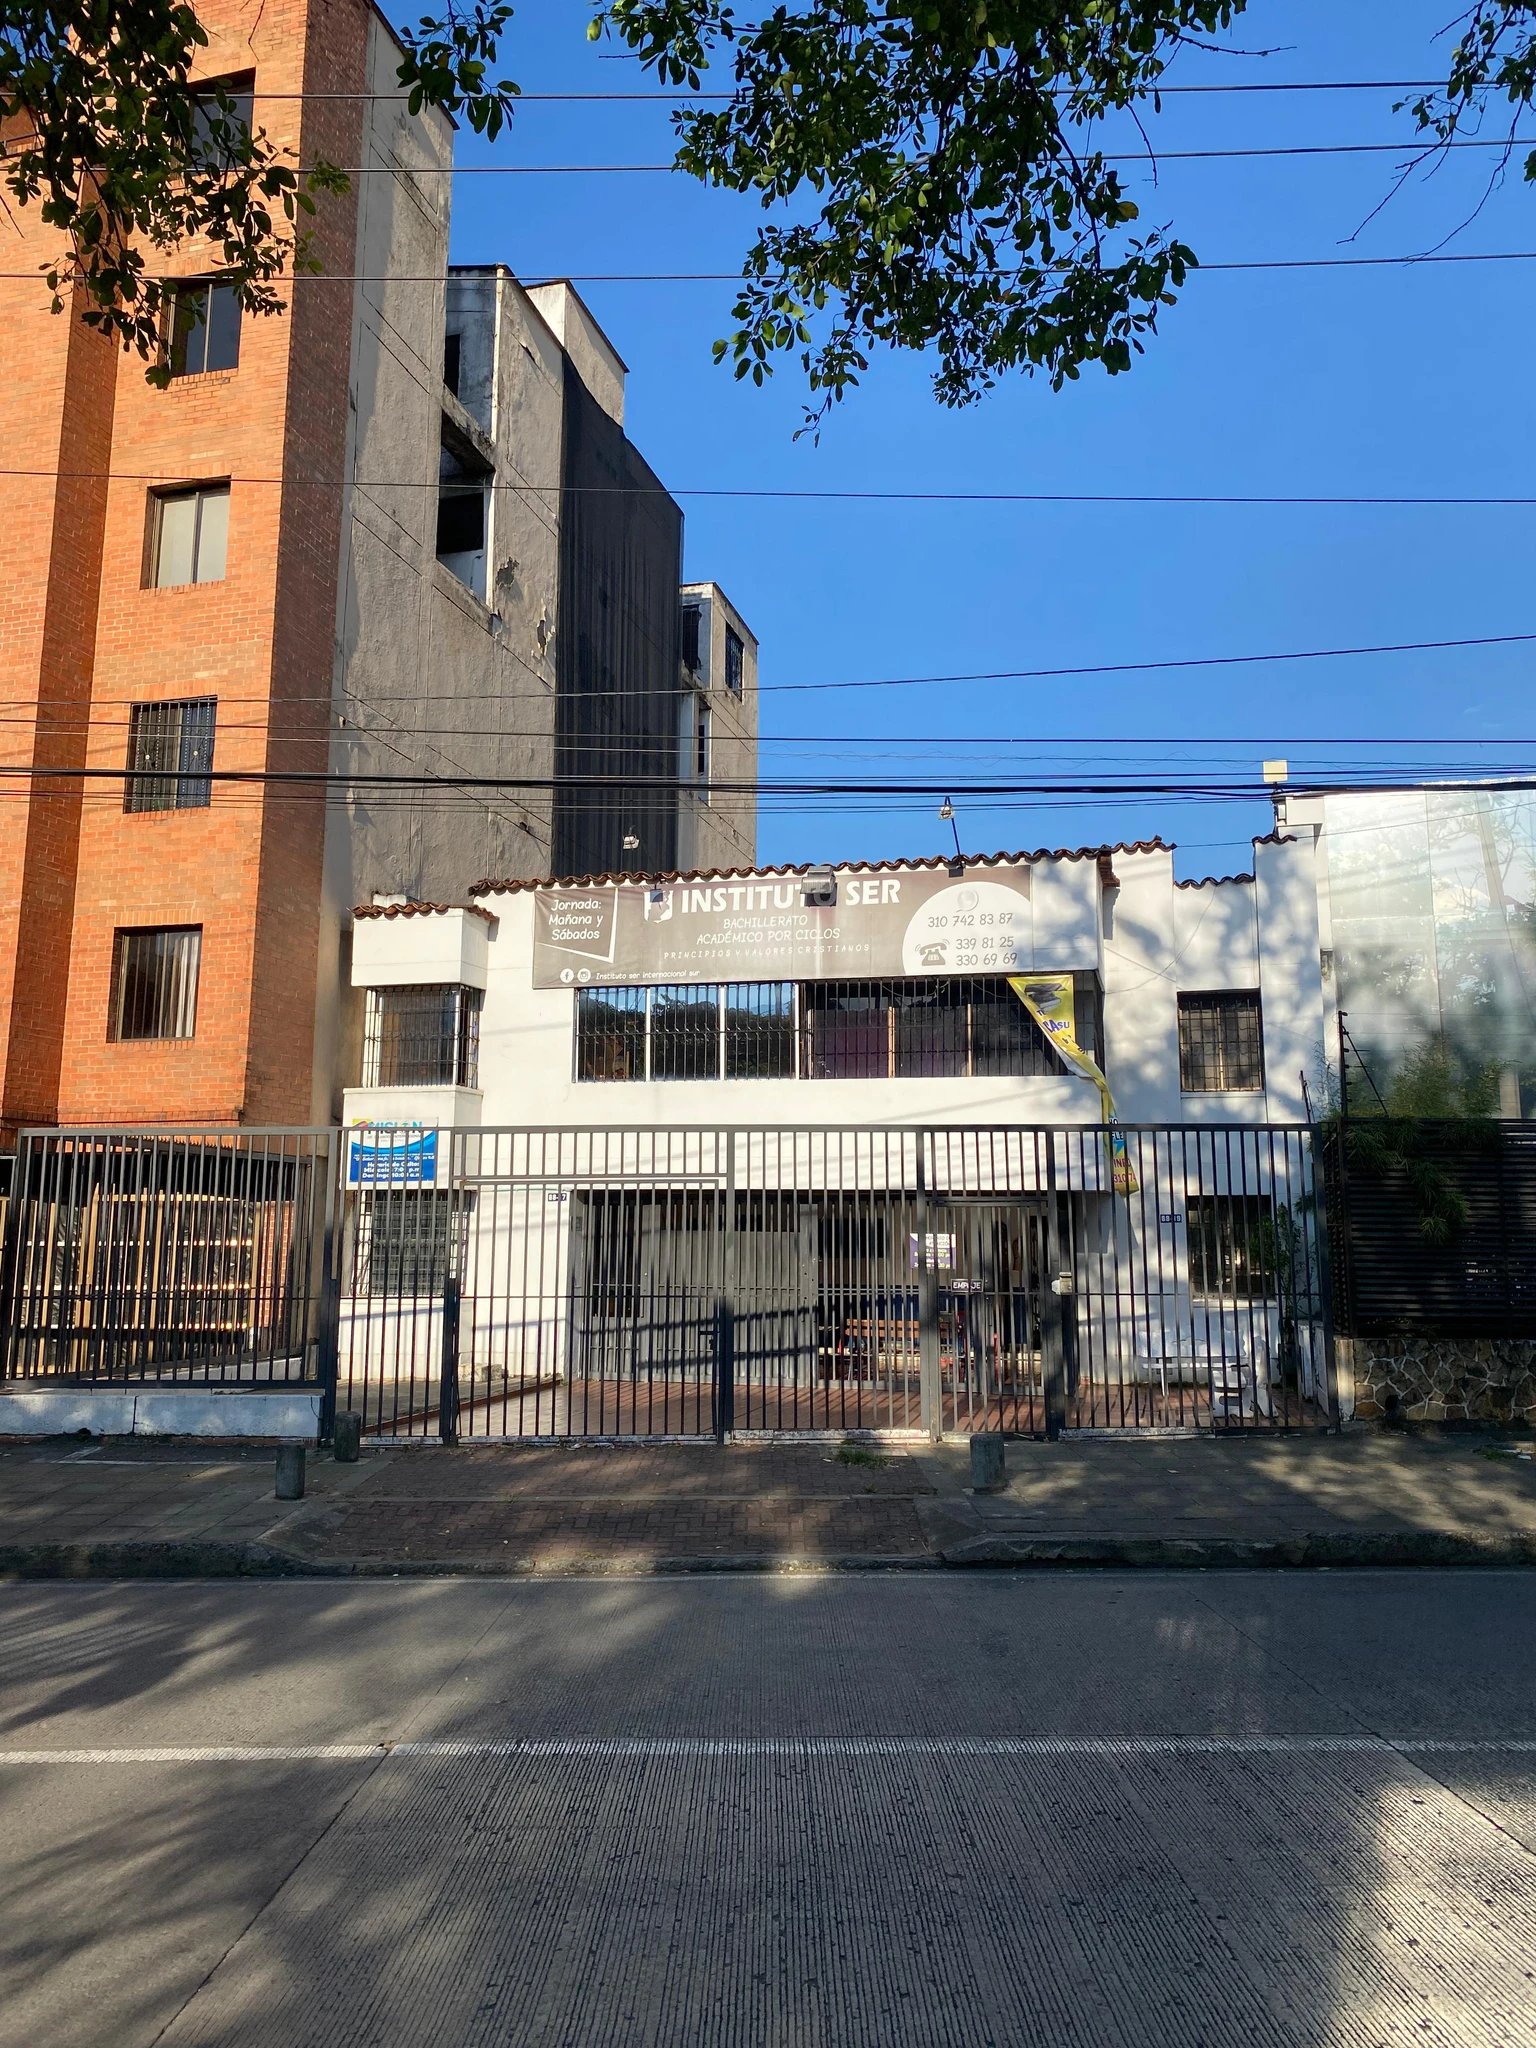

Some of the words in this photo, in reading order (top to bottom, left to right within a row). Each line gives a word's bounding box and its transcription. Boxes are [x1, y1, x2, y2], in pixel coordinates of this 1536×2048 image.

[845, 879, 901, 907] SER
[550, 898, 602, 911] Jornada:
[548, 914, 592, 926] Mañana
[596, 915, 604, 928] y
[723, 915, 808, 929] BACHILLERATO
[927, 916, 948, 928] 310
[952, 915, 975, 927] 742
[979, 913, 994, 926] 83
[998, 912, 1014, 925] 87
[551, 928, 600, 941] Sábados
[696, 930, 763, 945] ACADÉMICO
[767, 930, 792, 942] POR
[795, 928, 841, 940] CICLOS
[955, 938, 977, 950] 339
[981, 937, 995, 949] 81
[999, 936, 1014, 948] 25
[663, 949, 731, 960] PRINCIPIOS
[735, 949, 741, 957] Y
[745, 946, 793, 956] VALORES
[797, 944, 870, 954] CRISTIANOS
[956, 954, 978, 966] 330
[983, 953, 998, 966] 69
[1002, 952, 1018, 965] 69
[595, 972, 627, 980] Instituto
[642, 970, 687, 979] internacional
